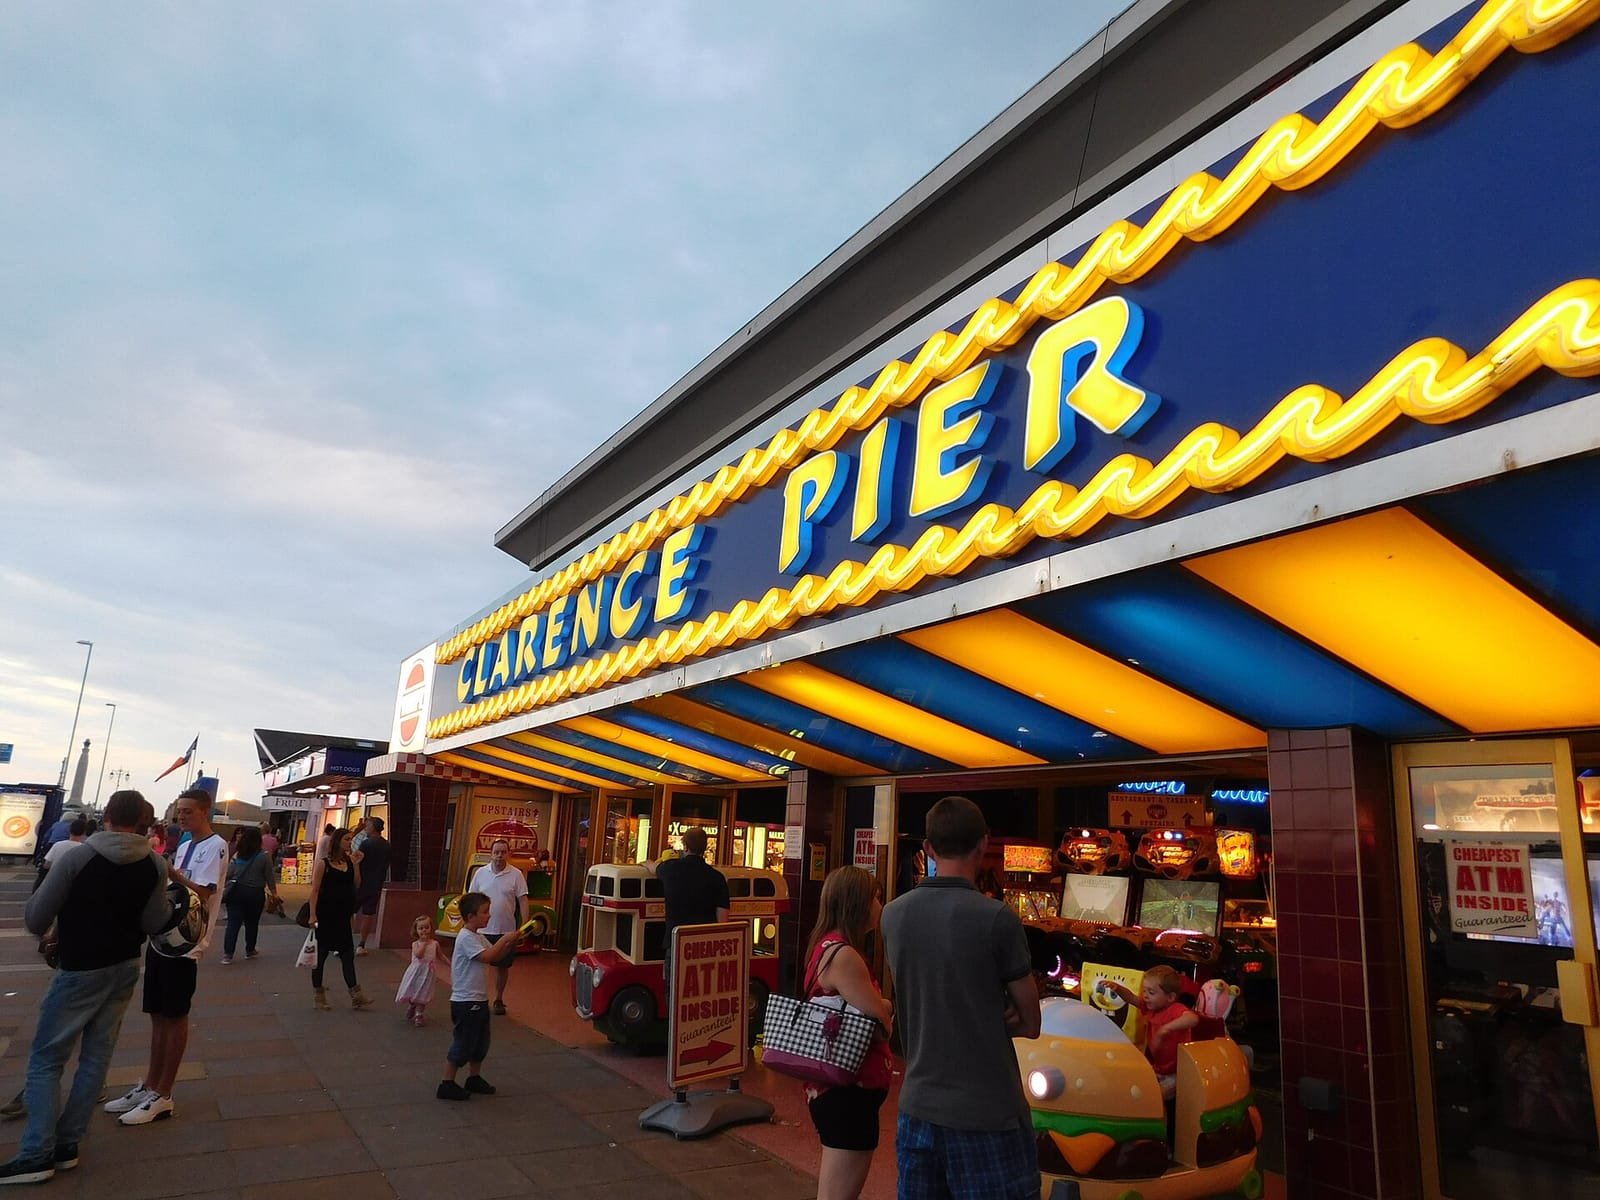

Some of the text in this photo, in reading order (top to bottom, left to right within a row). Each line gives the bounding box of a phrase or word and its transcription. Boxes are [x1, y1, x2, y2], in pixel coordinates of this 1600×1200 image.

[457, 296, 1161, 703] CLARENCE PIER
[275, 797, 306, 807] FRUIT
[481, 805, 531, 817] UPSTAIRS
[479, 836, 535, 849] WMPY
[855, 840, 876, 855] ATM
[854, 856, 876, 865] INSIDE
[1453, 847, 1520, 863] CHEAPEST
[1456, 865, 1525, 894] ATM
[1456, 894, 1528, 912] INSIDE
[1455, 912, 1533, 928] Guaranteed
[684, 938, 739, 960] CHEAPEST
[682, 960, 738, 998] ATM
[681, 996, 740, 1022] INSIDE
[680, 1013, 738, 1044] Guaranteed
